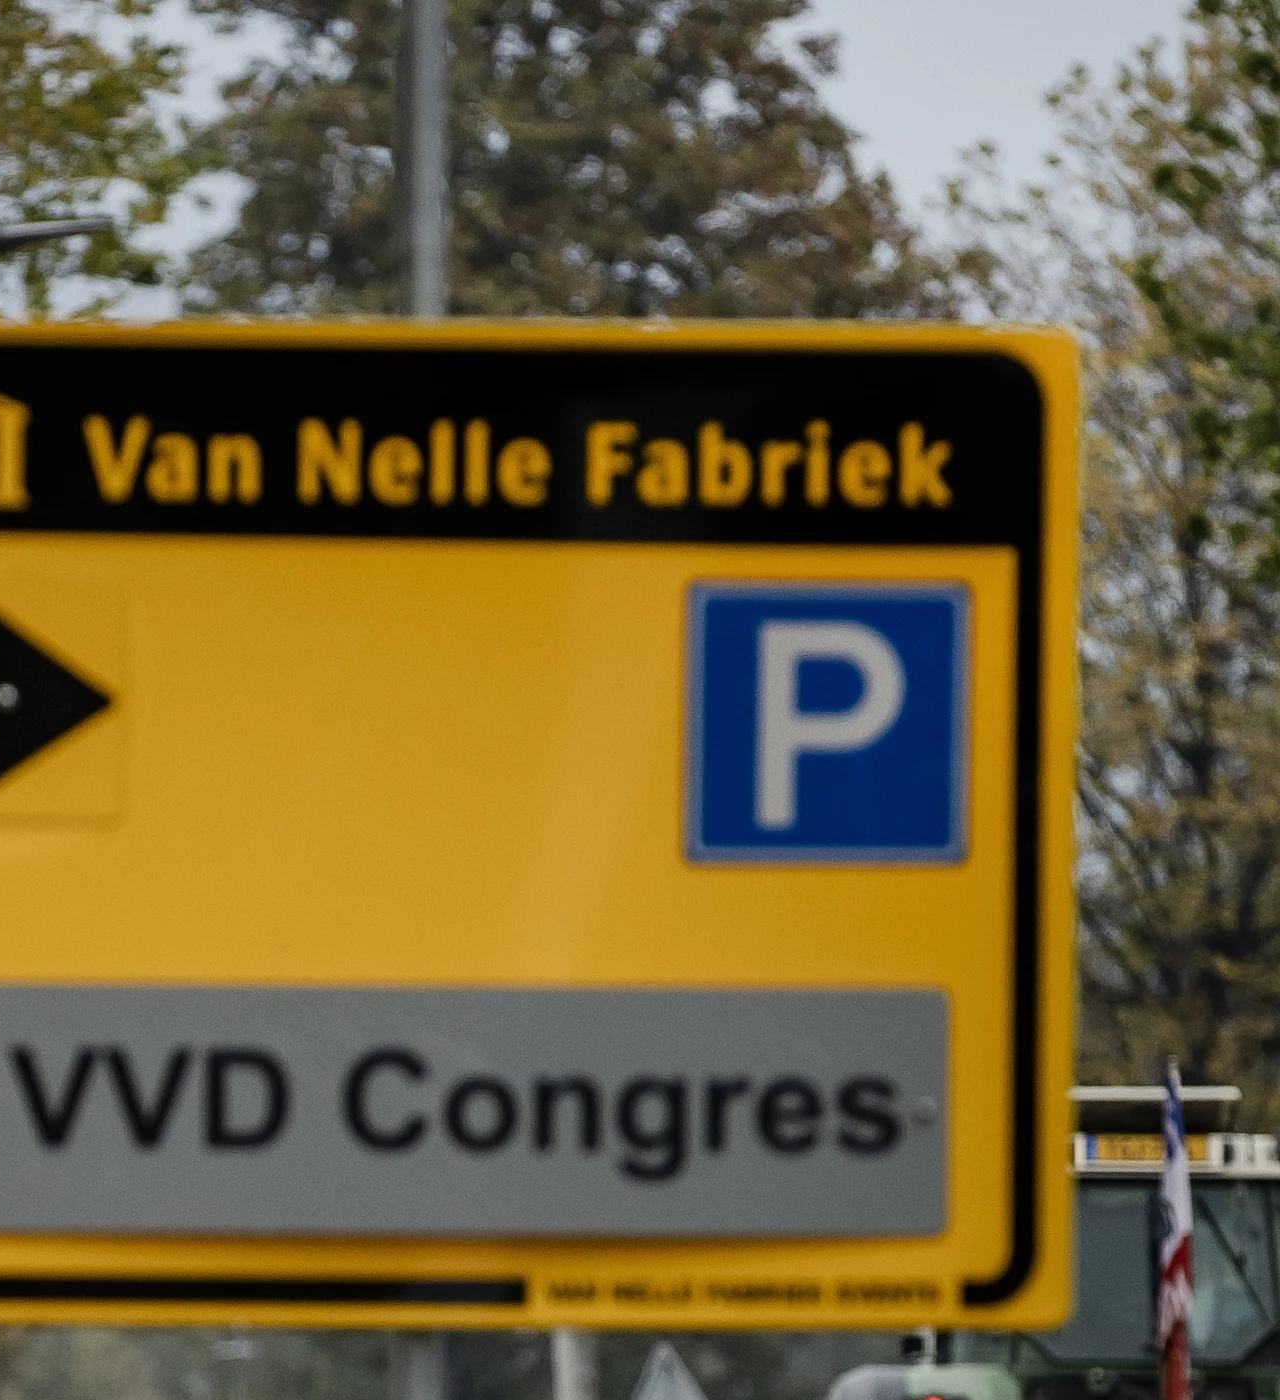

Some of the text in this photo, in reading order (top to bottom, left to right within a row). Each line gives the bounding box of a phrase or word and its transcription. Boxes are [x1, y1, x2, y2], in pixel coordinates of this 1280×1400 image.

[83, 414, 954, 510] Van Nelle Fabriek
[755, 619, 907, 831] P
[7, 1045, 903, 1182] VVD Congres
